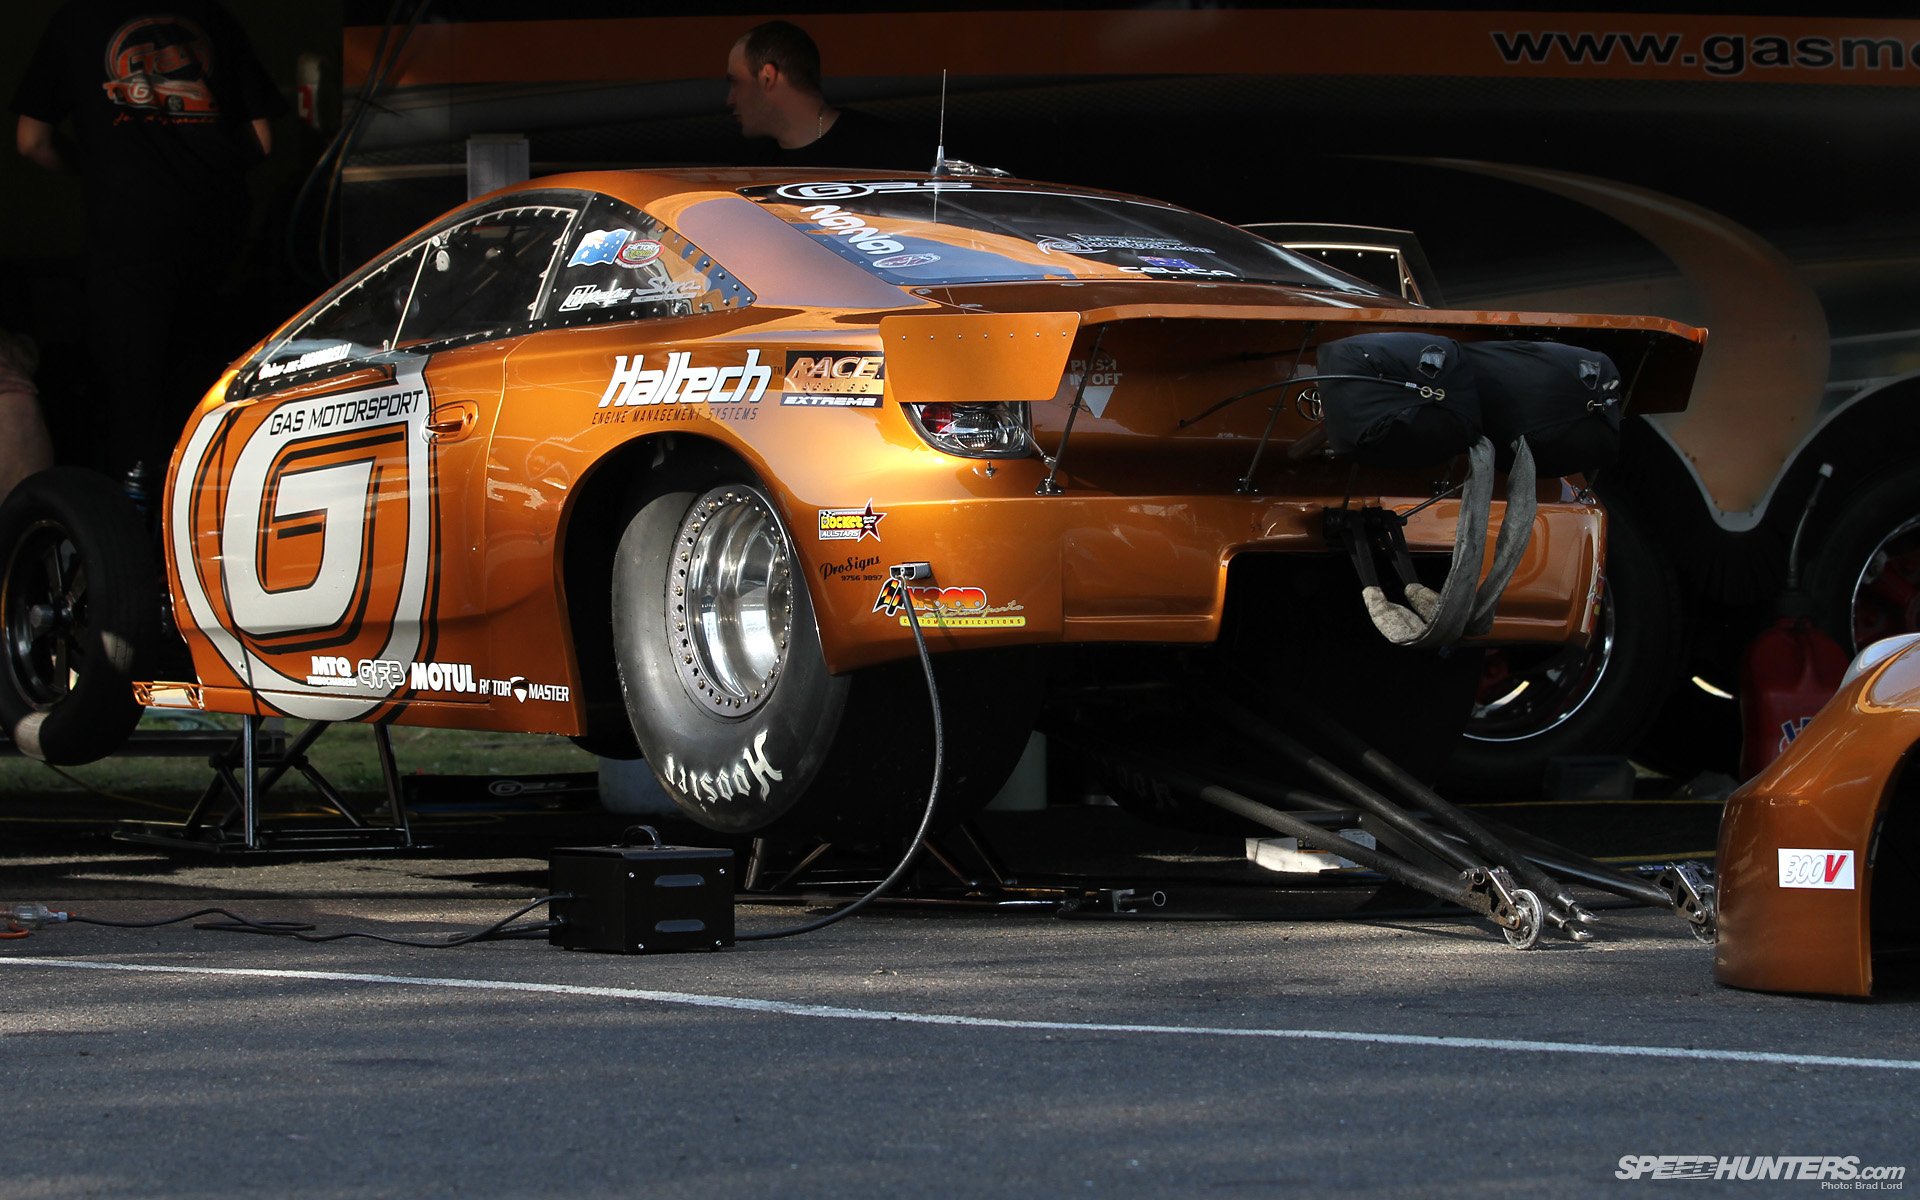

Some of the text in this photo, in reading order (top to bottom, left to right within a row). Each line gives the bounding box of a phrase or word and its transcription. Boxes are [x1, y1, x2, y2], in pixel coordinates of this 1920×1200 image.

[1493, 31, 1920, 77] www.gasm
[1118, 266, 1237, 278] CELICA
[597, 349, 772, 408] Haltech
[785, 356, 884, 379] RACE
[1092, 373, 1123, 385] OFF
[270, 390, 423, 436] GAS MOTORSPORT
[783, 396, 877, 407] EXTREME
[591, 407, 760, 425] ENGINE MANAGEMENT SYSTEMS
[821, 529, 861, 538] ALLSTARS
[819, 556, 881, 580] ProSigns
[311, 656, 352, 677] MTQ
[358, 659, 406, 689] GFB
[410, 662, 477, 692] MOTUL
[528, 683, 570, 702] MASTER
[1785, 853, 1849, 885] 300V
